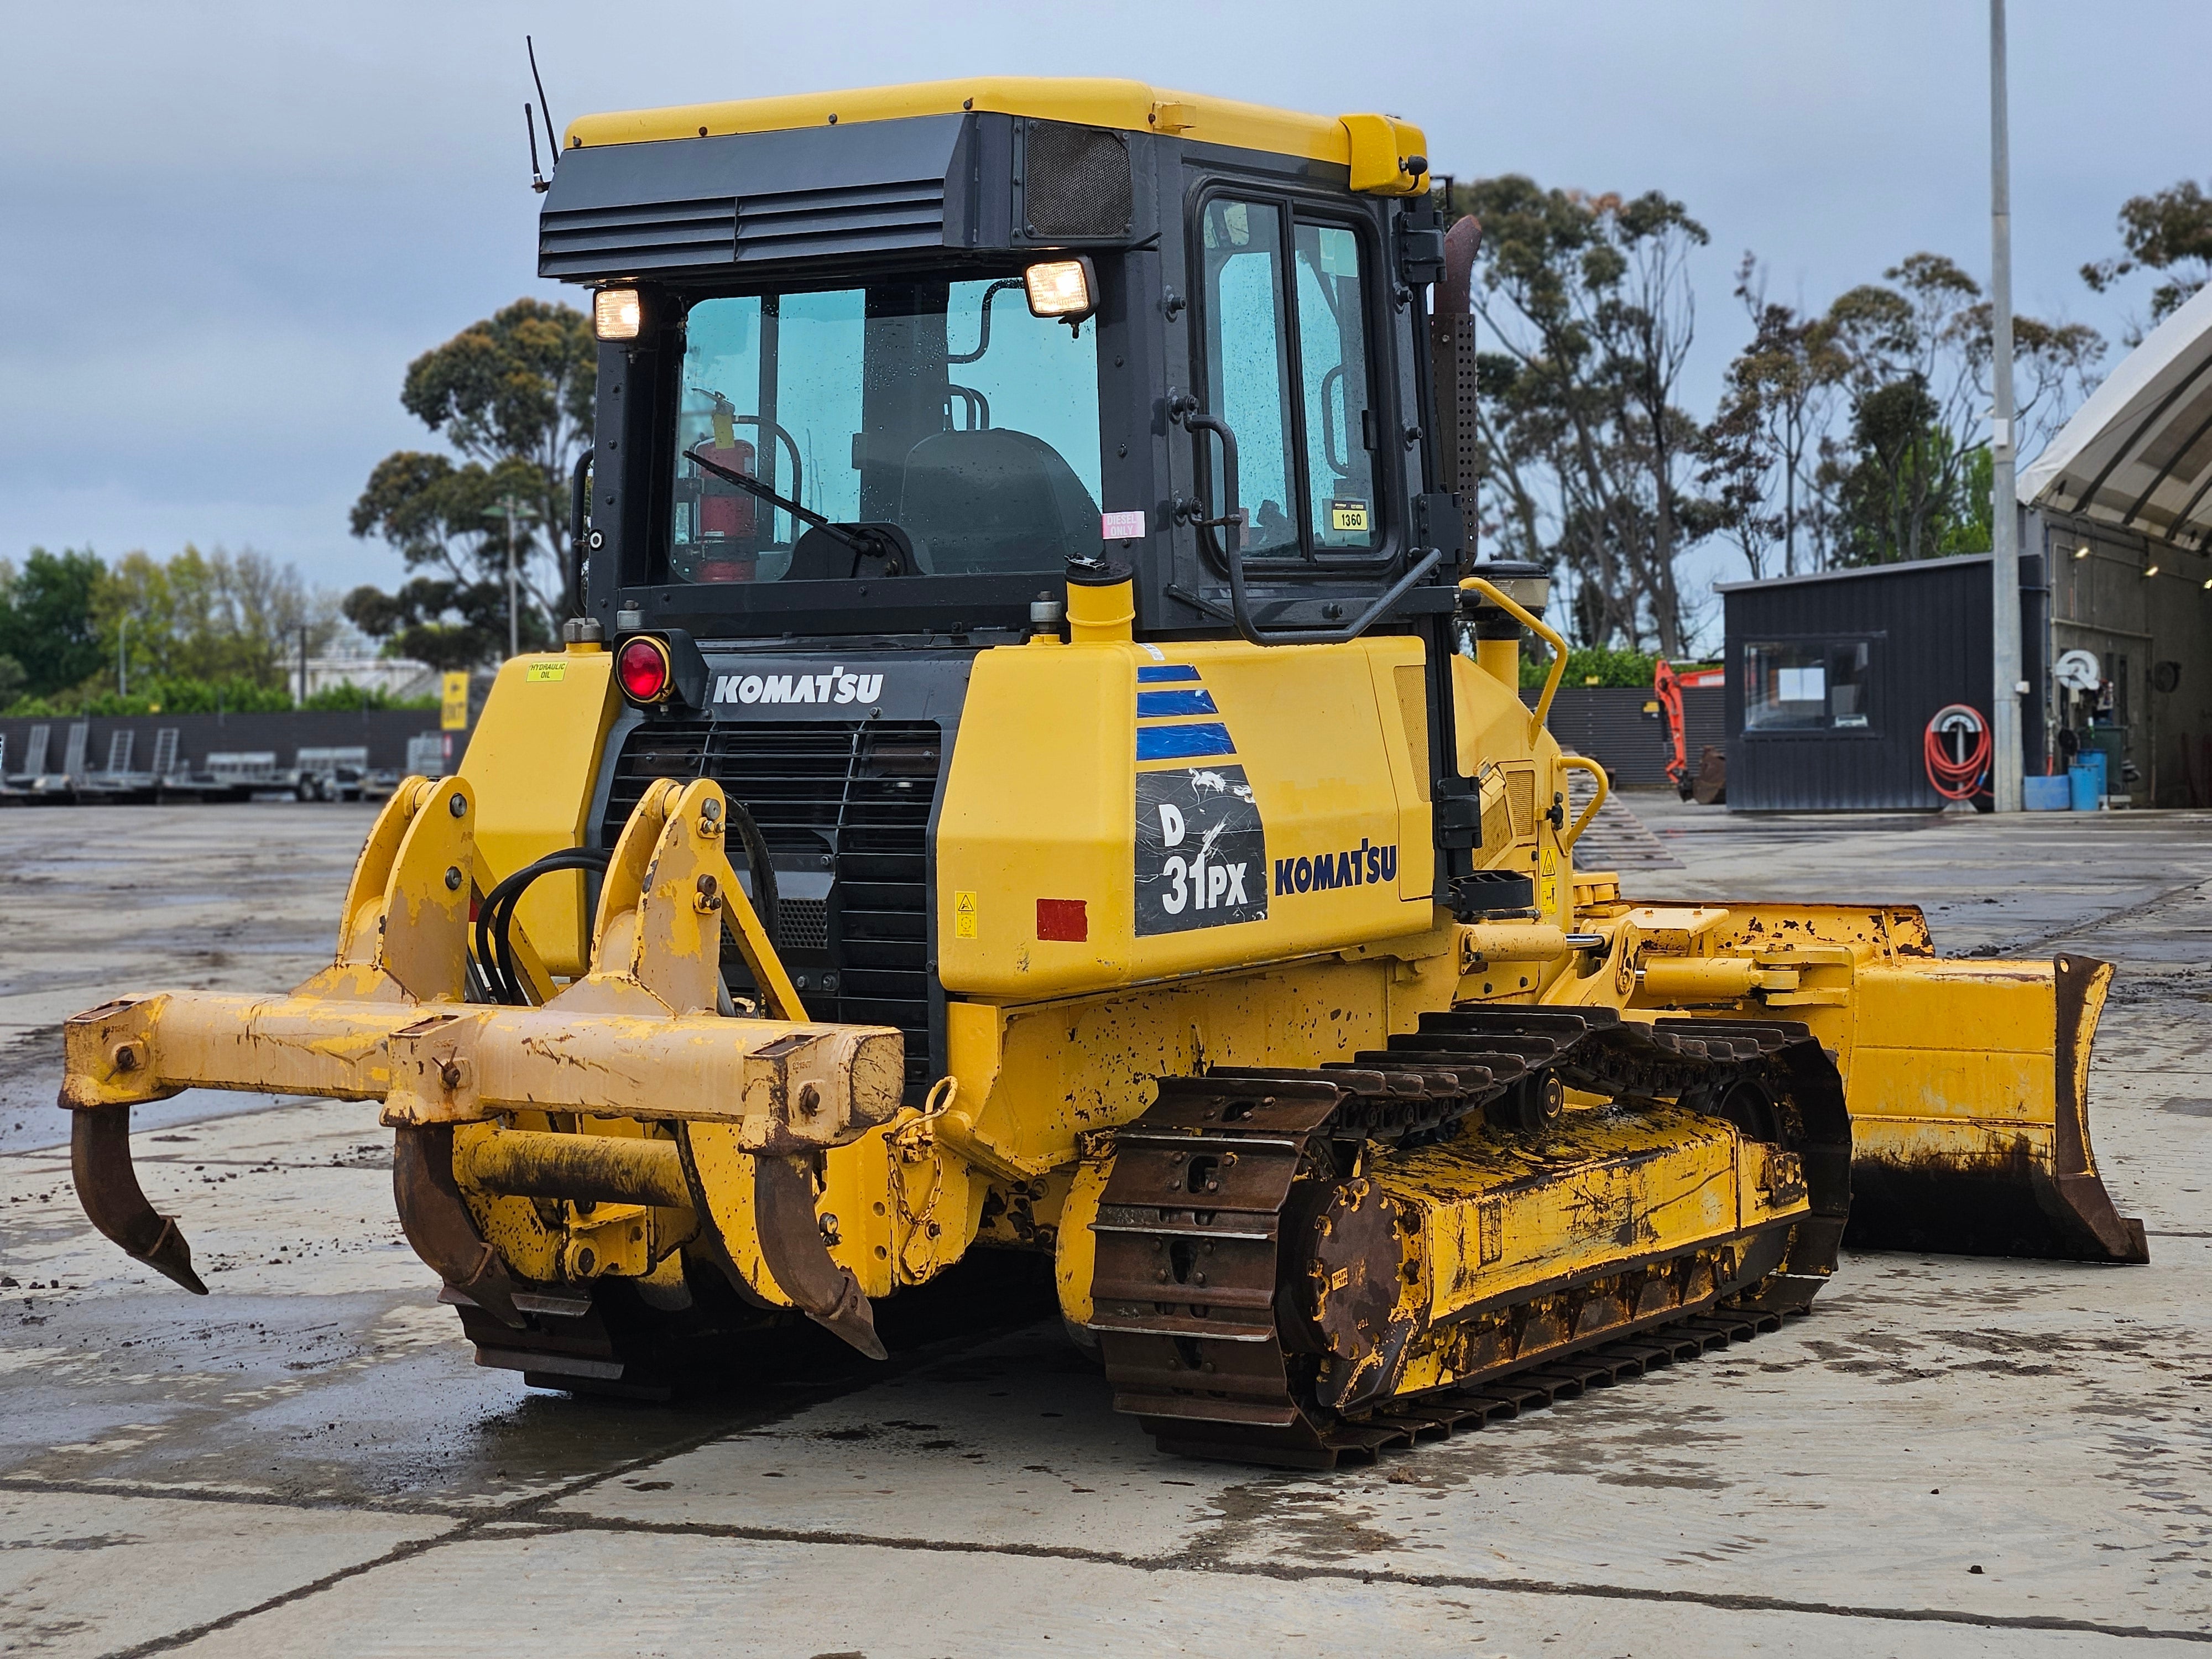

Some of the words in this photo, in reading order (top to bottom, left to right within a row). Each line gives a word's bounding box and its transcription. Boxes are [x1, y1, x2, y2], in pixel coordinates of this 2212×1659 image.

[1107, 513, 1136, 525] DIESEL
[1110, 525, 1133, 536] ONLY
[1342, 513, 1362, 527] 1360
[713, 666, 884, 703] KOMATSU
[1158, 804, 1186, 847] D
[1275, 837, 1397, 896] KOMATSU
[1161, 853, 1249, 915] 31PX
[1357, 1317, 1369, 1330] TOP
